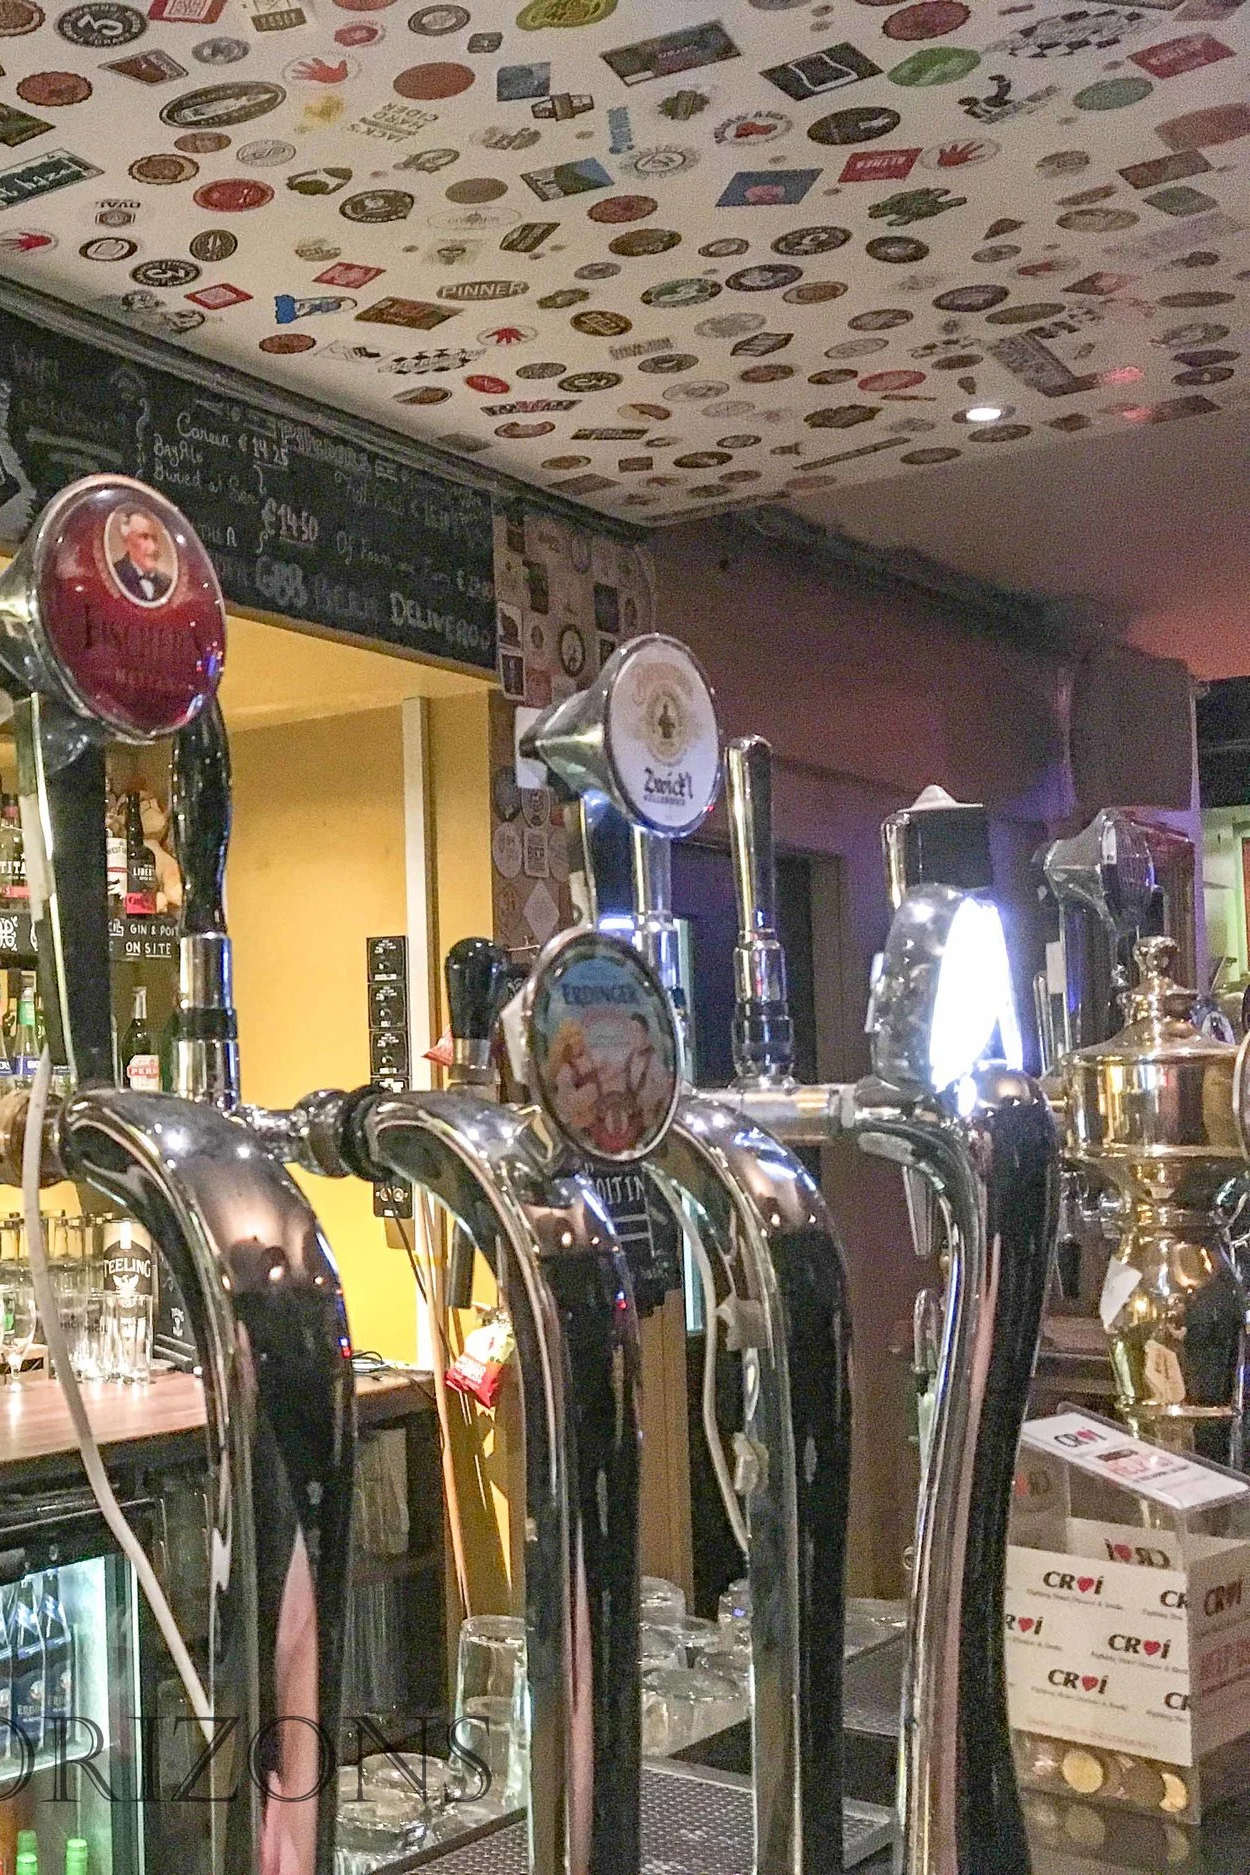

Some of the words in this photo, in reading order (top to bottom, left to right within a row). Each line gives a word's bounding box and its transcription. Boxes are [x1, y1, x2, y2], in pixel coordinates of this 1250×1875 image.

[440, 280, 528, 299] PINNER
[129, 923, 148, 936] GIN
[125, 941, 142, 955] ON
[144, 942, 172, 956] SITE
[102, 1257, 152, 1279] TEELING
